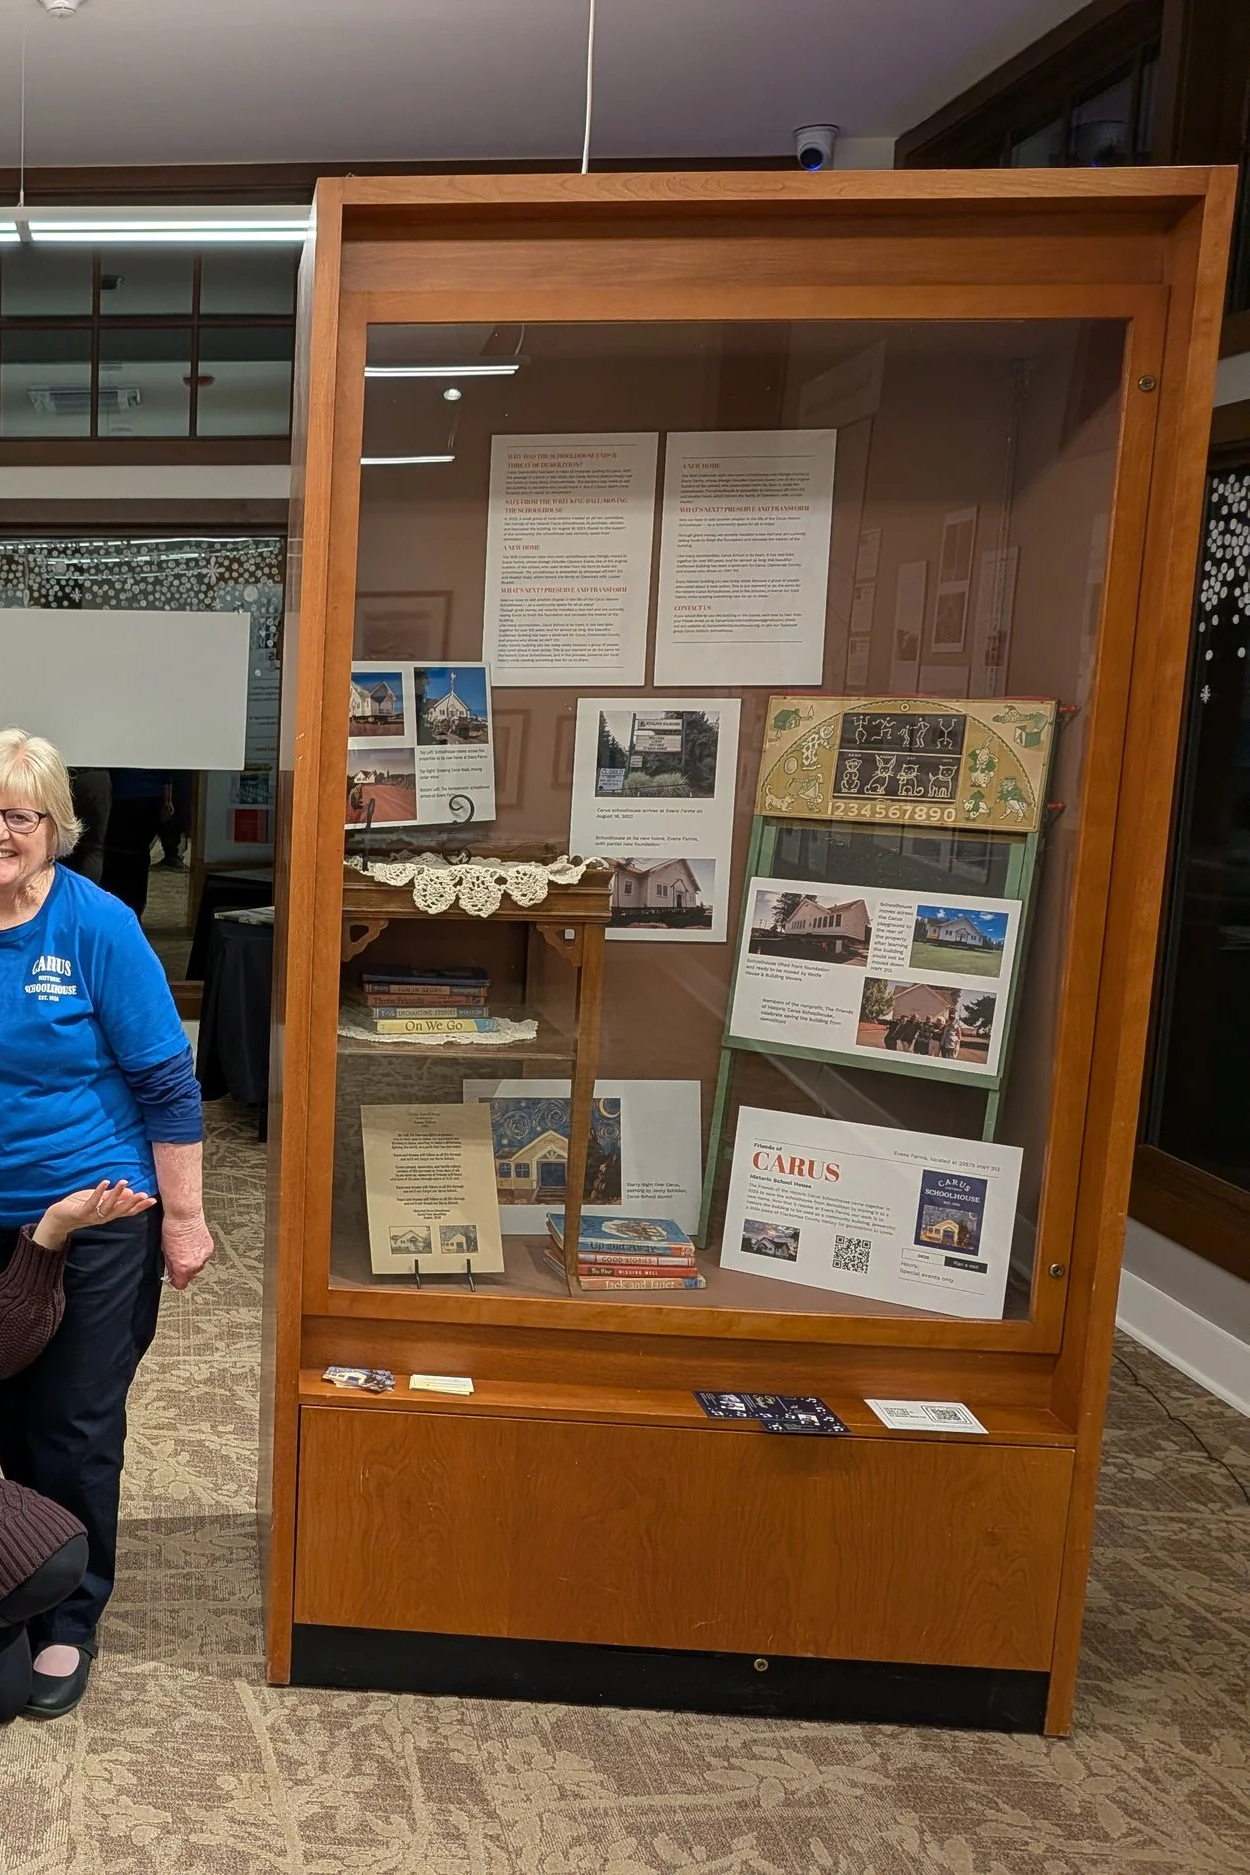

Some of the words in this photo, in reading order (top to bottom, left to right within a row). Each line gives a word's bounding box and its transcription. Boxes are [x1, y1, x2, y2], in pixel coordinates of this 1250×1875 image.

[32, 955, 72, 976] CARUS
[25, 983, 77, 995] SCHOOLHOUSE
[406, 1021, 422, 1031] On
[426, 1021, 443, 1030] We
[446, 1021, 463, 1030] Go
[754, 1143, 775, 1151] Friends
[911, 1153, 929, 1162] Farms,
[752, 1151, 840, 1182] CARUS
[938, 1179, 970, 1192] CARUS
[822, 1196, 850, 1204] Schoolhouse
[925, 1188, 980, 1203] SCHOOLHOUSE
[590, 1242, 605, 1251] Up
[625, 1244, 657, 1253] Away
[900, 1268, 920, 1277] Special
[605, 1280, 625, 1289] Jack
[630, 1281, 646, 1289] and
